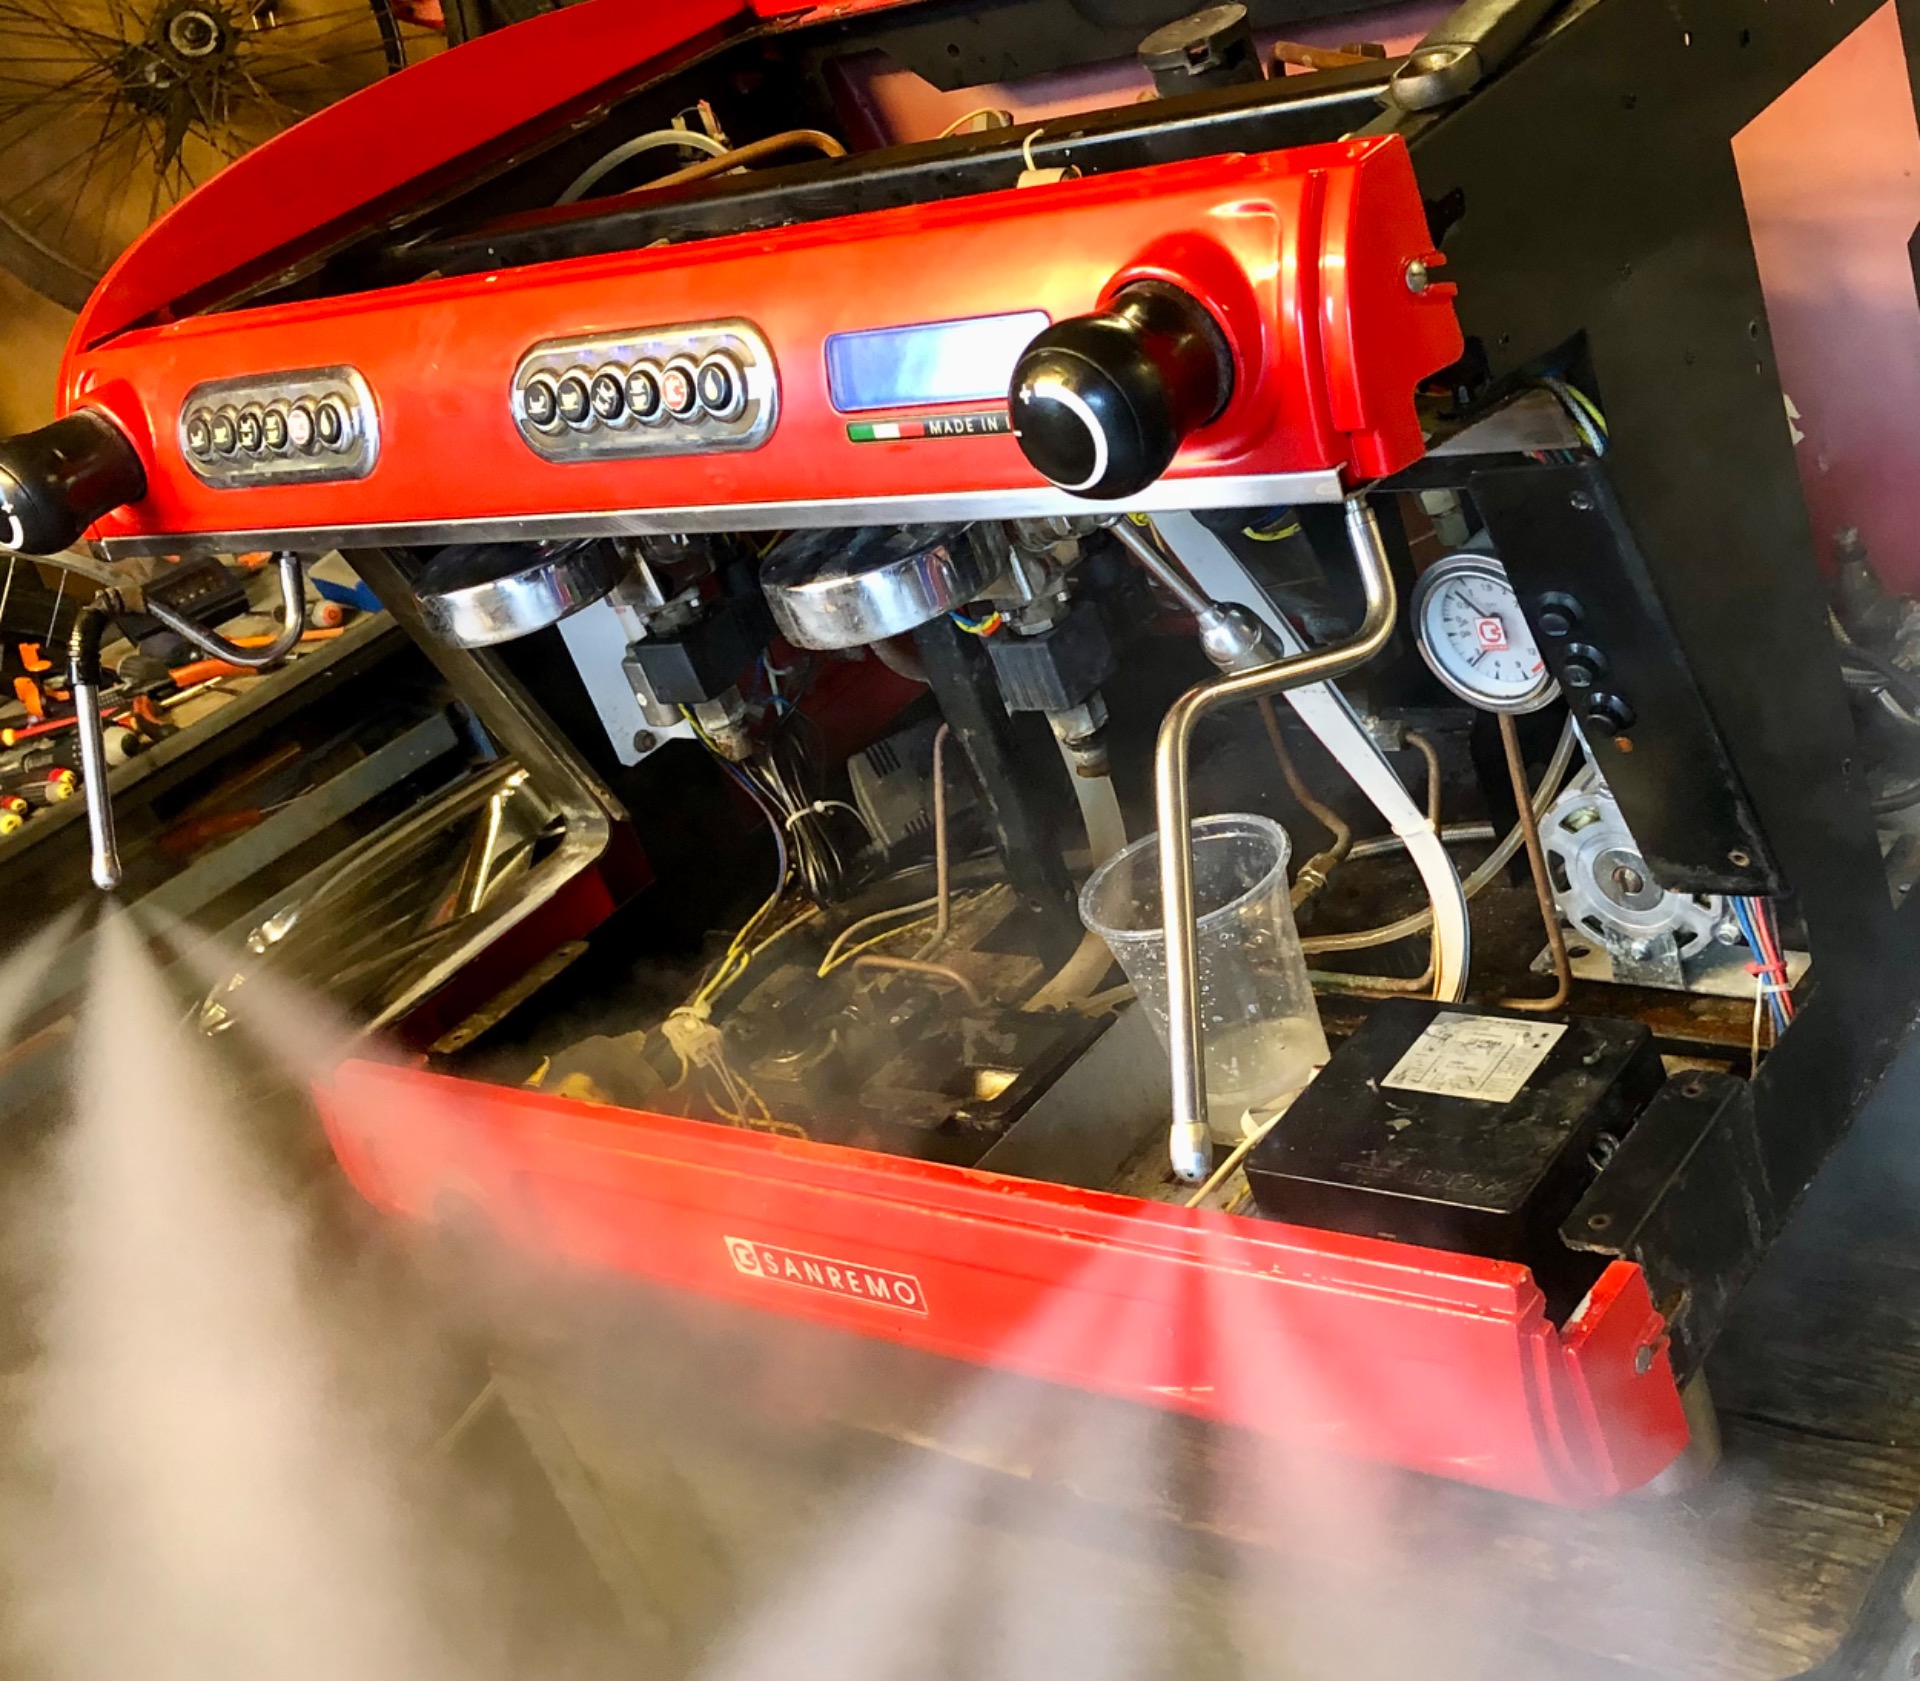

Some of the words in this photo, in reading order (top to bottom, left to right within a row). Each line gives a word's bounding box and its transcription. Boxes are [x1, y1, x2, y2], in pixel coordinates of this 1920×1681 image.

[928, 417, 975, 435] MADE
[981, 416, 998, 432] IN
[763, 1251, 916, 1305] SANREMO
